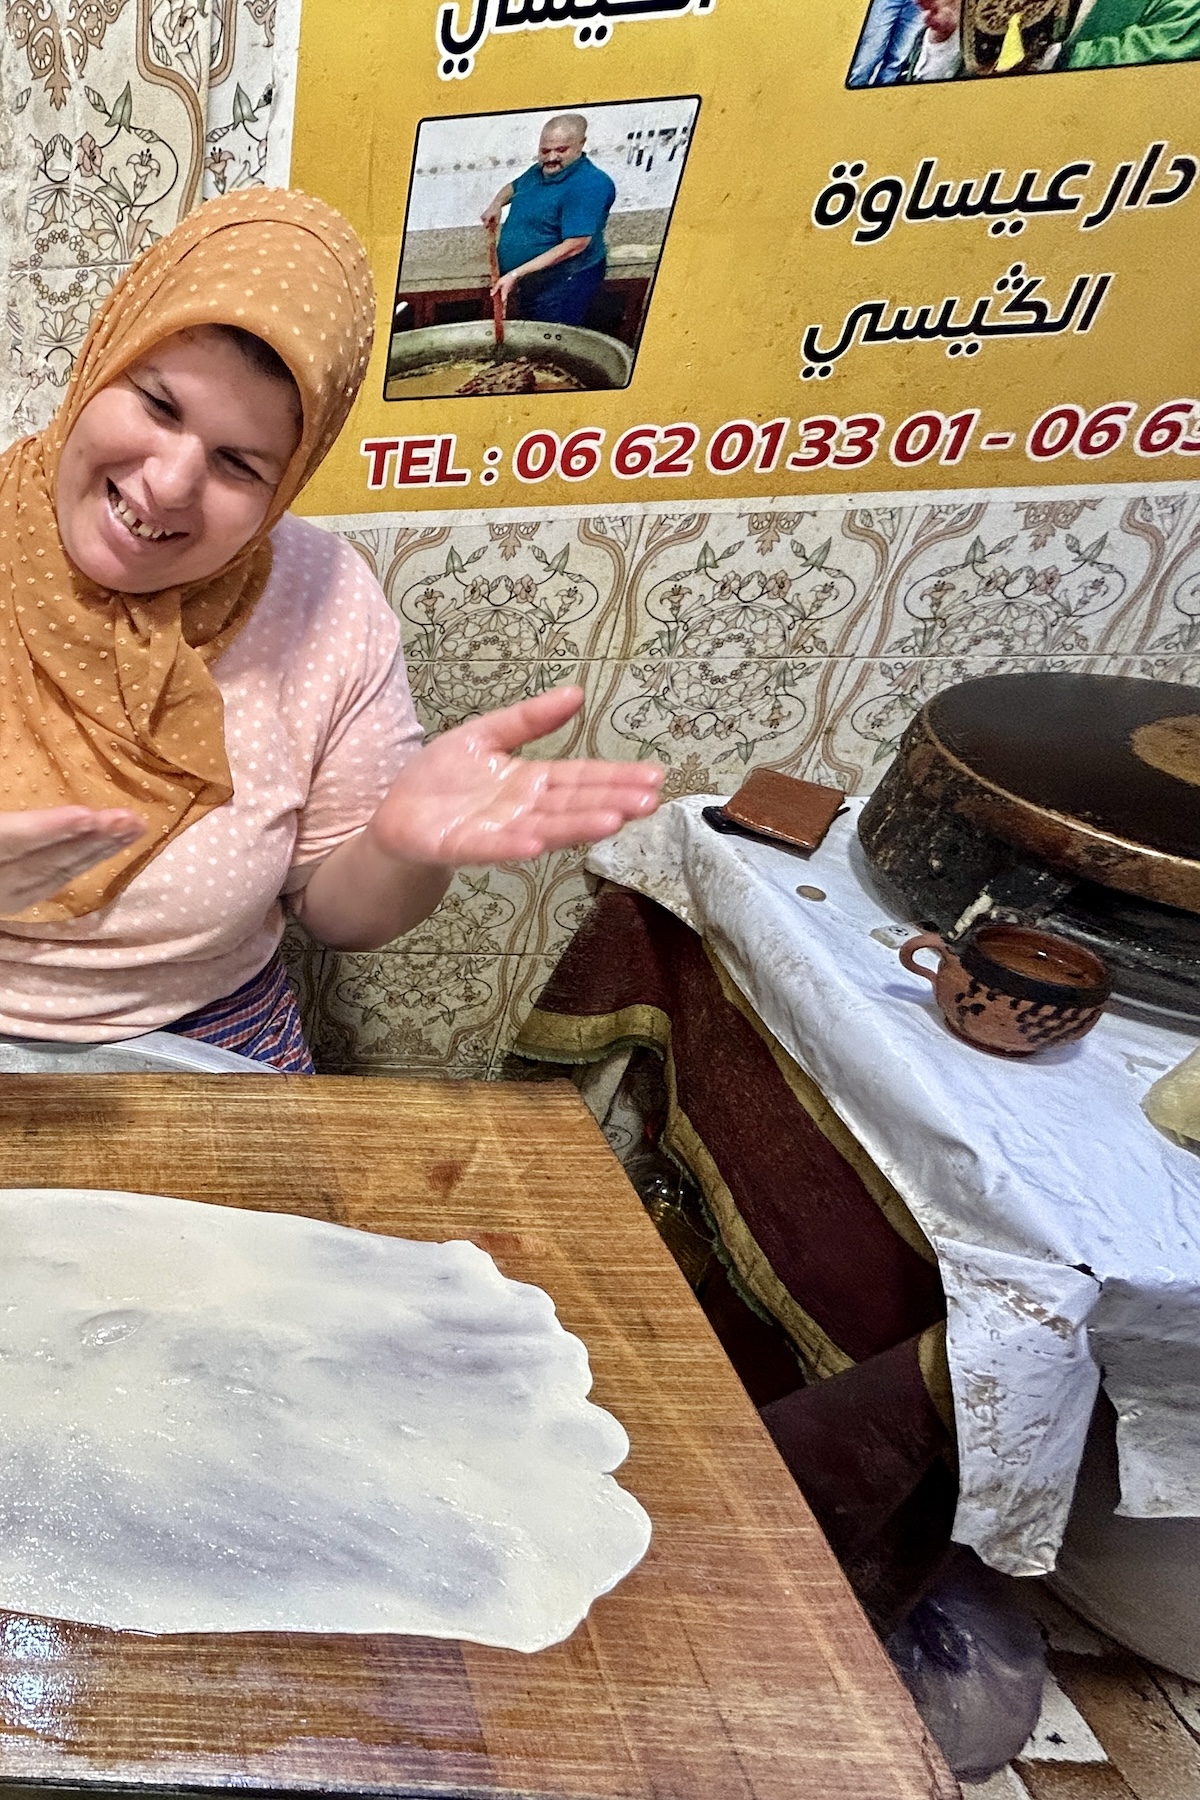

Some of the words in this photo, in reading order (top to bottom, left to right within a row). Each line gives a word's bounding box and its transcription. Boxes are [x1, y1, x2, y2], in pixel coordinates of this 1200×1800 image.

[812, 158, 1093, 243] عيساوة
[1080, 143, 1198, 229] دار
[363, 438, 467, 486] TEL
[516, 431, 602, 480] 06
[613, 426, 696, 476] 62
[893, 412, 975, 463] 01
[1029, 404, 1133, 457] 06
